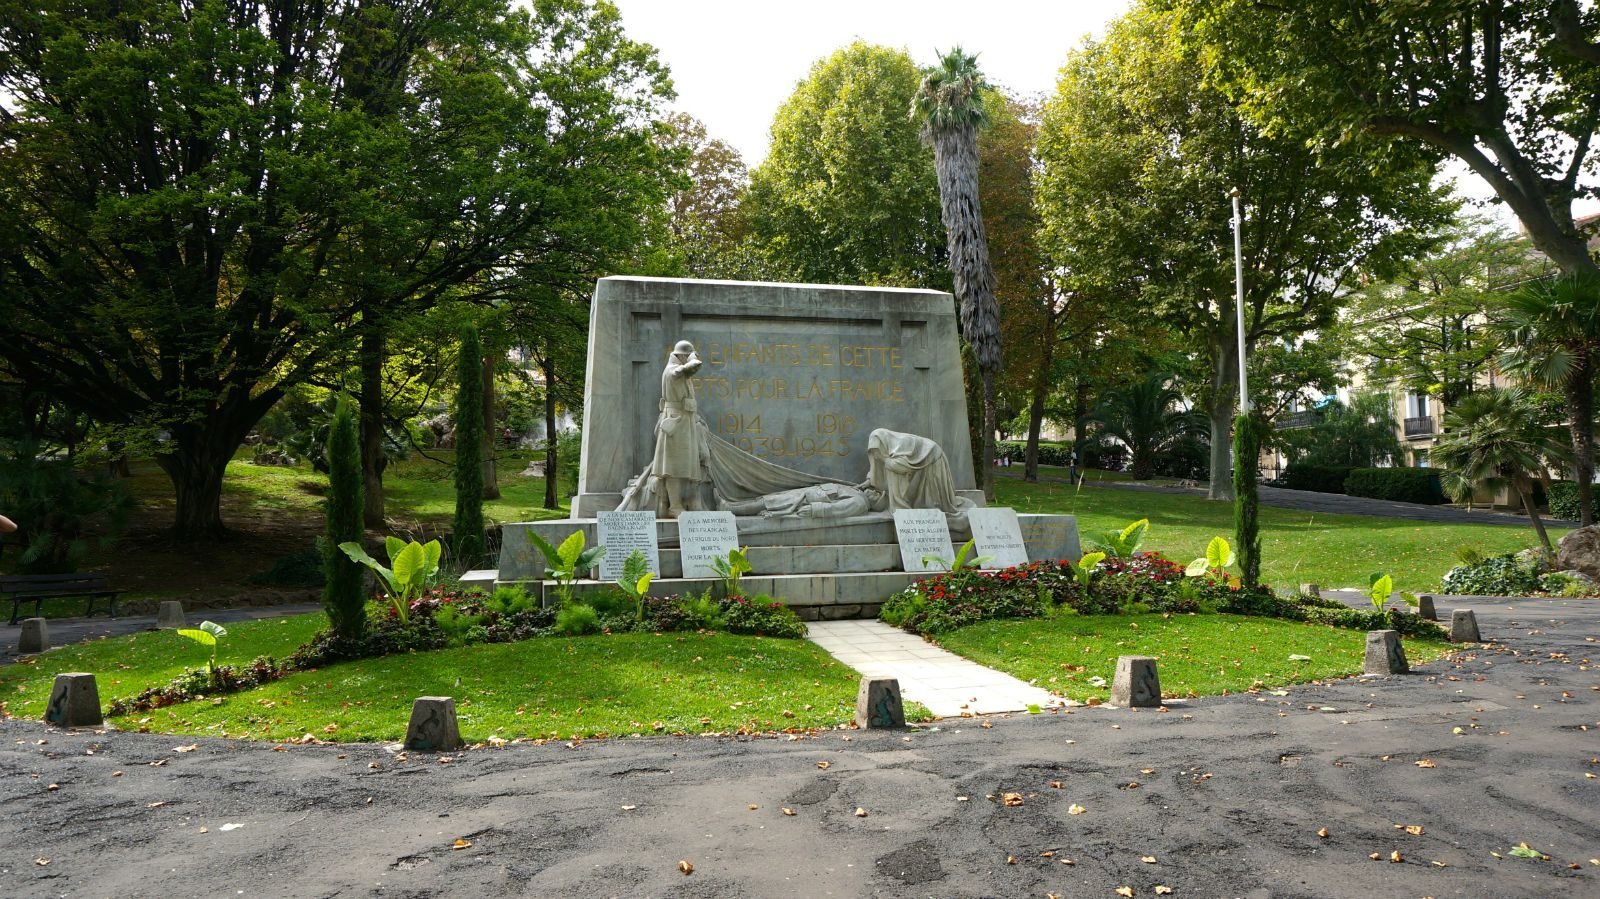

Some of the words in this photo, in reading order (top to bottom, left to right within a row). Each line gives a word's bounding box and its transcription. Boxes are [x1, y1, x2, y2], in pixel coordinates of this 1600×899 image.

[709, 343, 801, 366] ENFANTS
[808, 344, 833, 367] DE
[839, 345, 905, 368] CETTE
[735, 378, 788, 401] POUR
[829, 379, 905, 401] FRANCE
[717, 412, 763, 434] 1914
[816, 413, 858, 436] 1918
[795, 437, 851, 458] 1945
